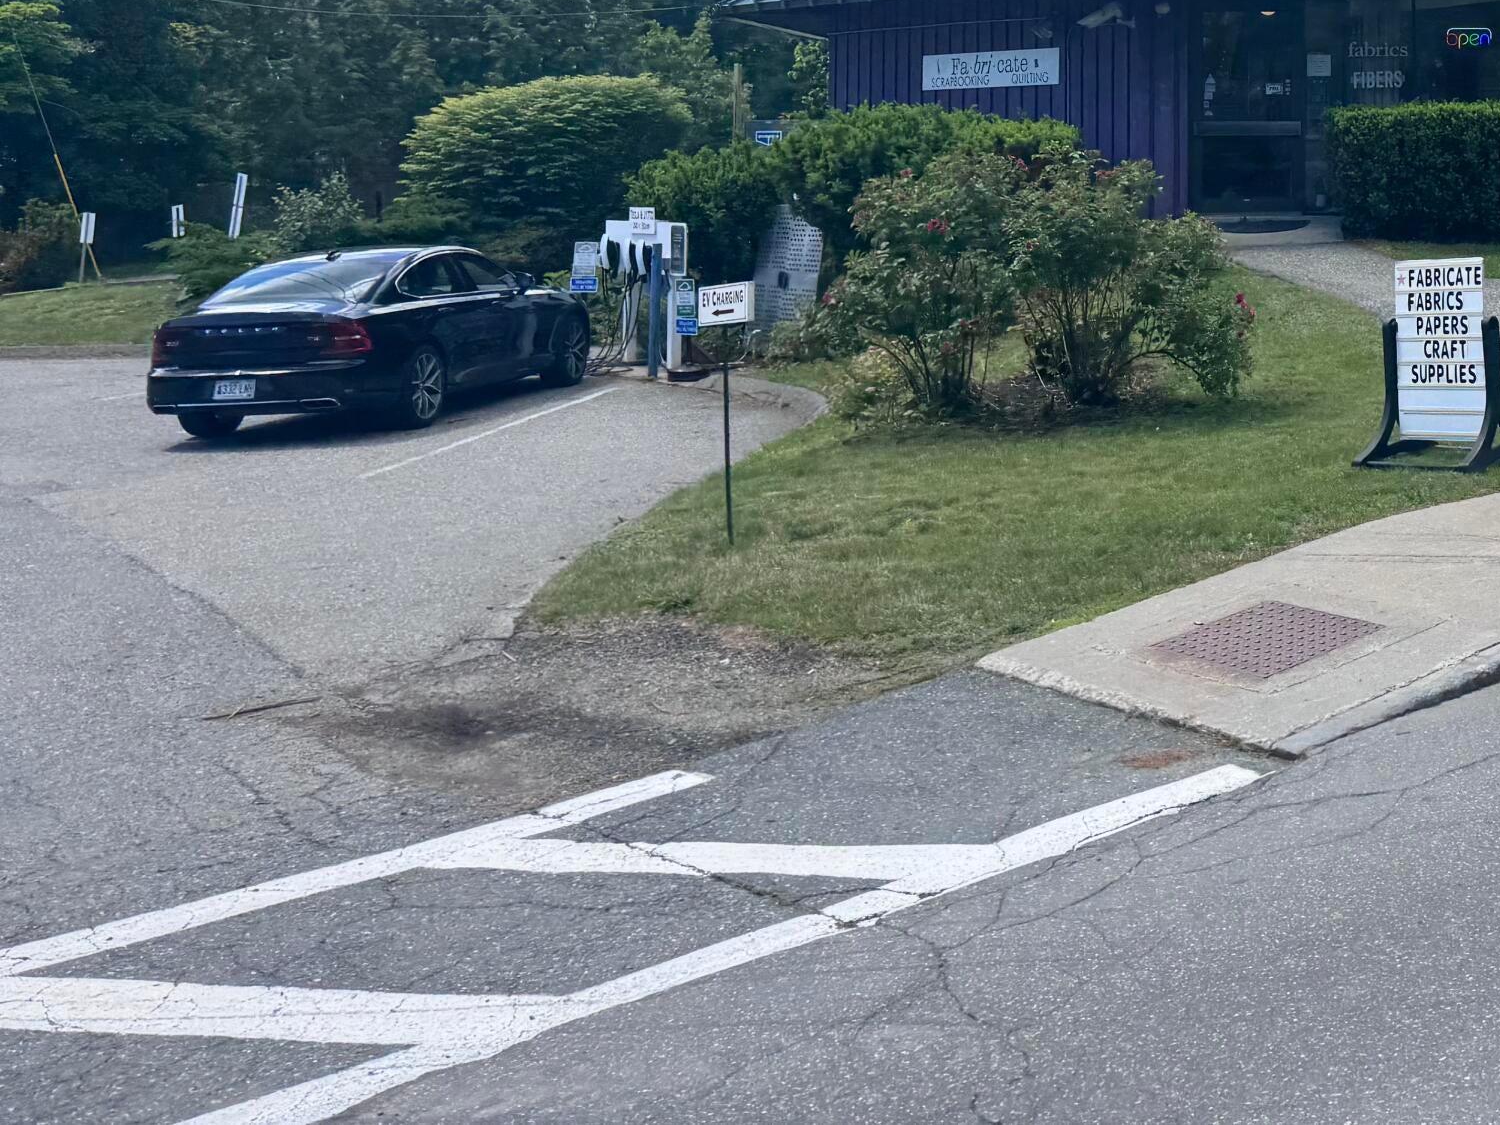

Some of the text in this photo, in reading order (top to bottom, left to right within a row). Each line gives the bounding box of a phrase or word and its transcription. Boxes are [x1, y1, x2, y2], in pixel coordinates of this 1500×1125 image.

[1347, 40, 1408, 57] fabrics
[1447, 33, 1490, 50] open
[931, 72, 1049, 88] SCRAPBOOKING QUILTING
[1352, 70, 1403, 89] FIBERS
[1408, 266, 1482, 288] FABRICATE
[702, 292, 711, 307] EV
[1407, 291, 1464, 311] FABRICS
[1416, 315, 1469, 336] PAPERS
[1423, 339, 1467, 359] CRAFT
[1411, 364, 1477, 384] SUPPLIES
